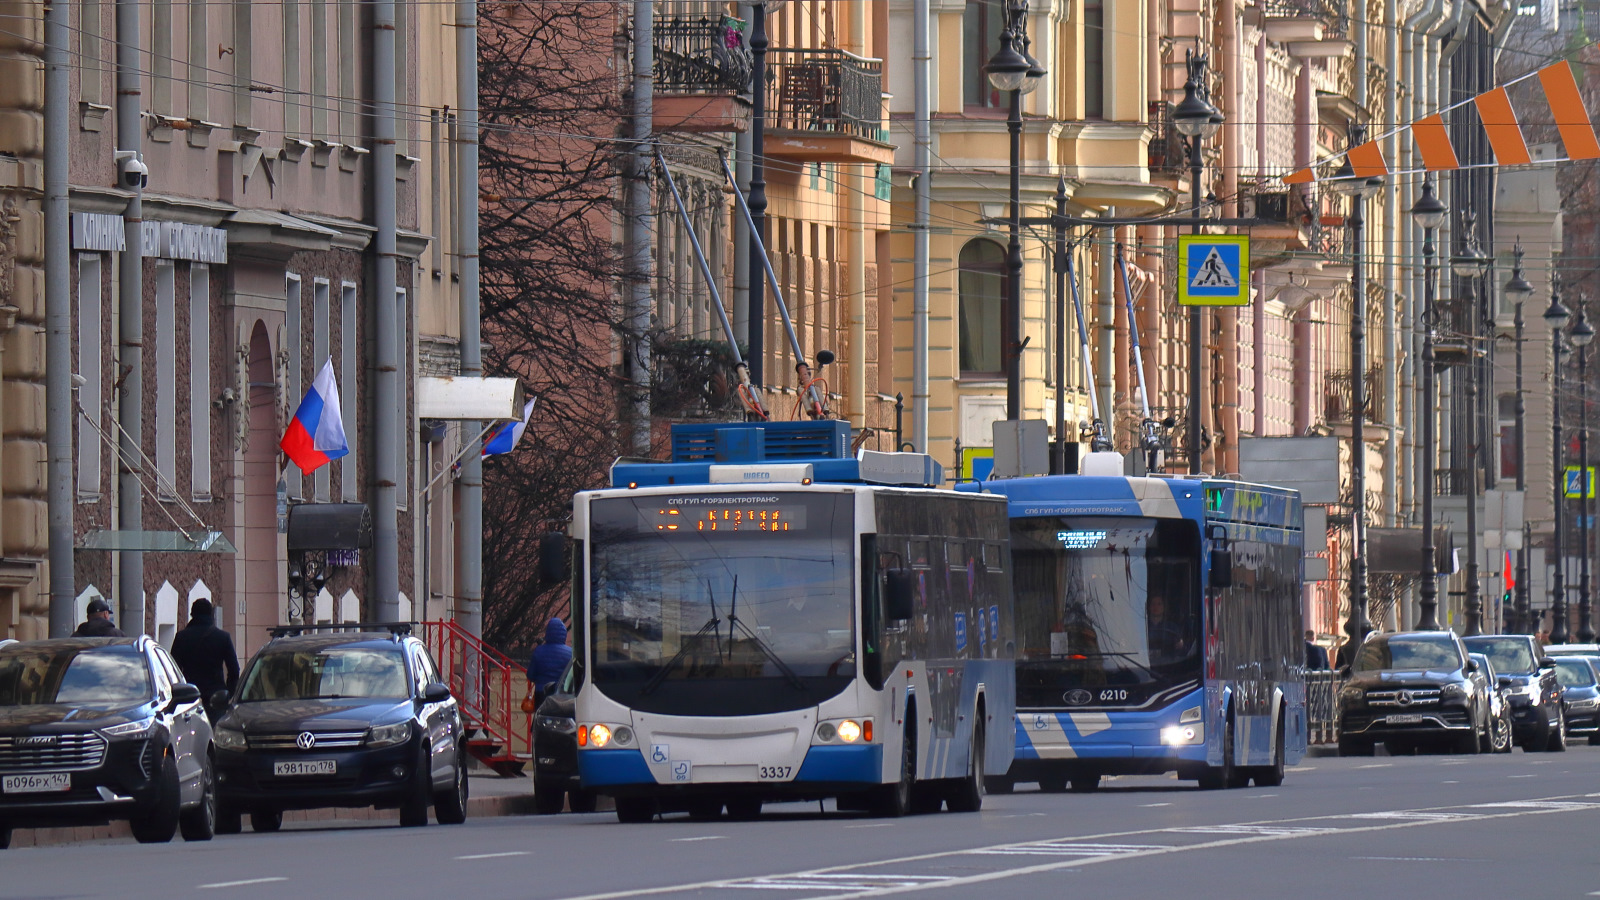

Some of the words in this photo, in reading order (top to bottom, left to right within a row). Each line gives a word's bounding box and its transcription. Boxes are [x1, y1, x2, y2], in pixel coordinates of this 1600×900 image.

[82, 212, 126, 251] КЛИНИКА
[1100, 689, 1127, 700] 6210
[319, 761, 334, 770] 178
[760, 766, 792, 779] 3337
[52, 774, 68, 783] 147
